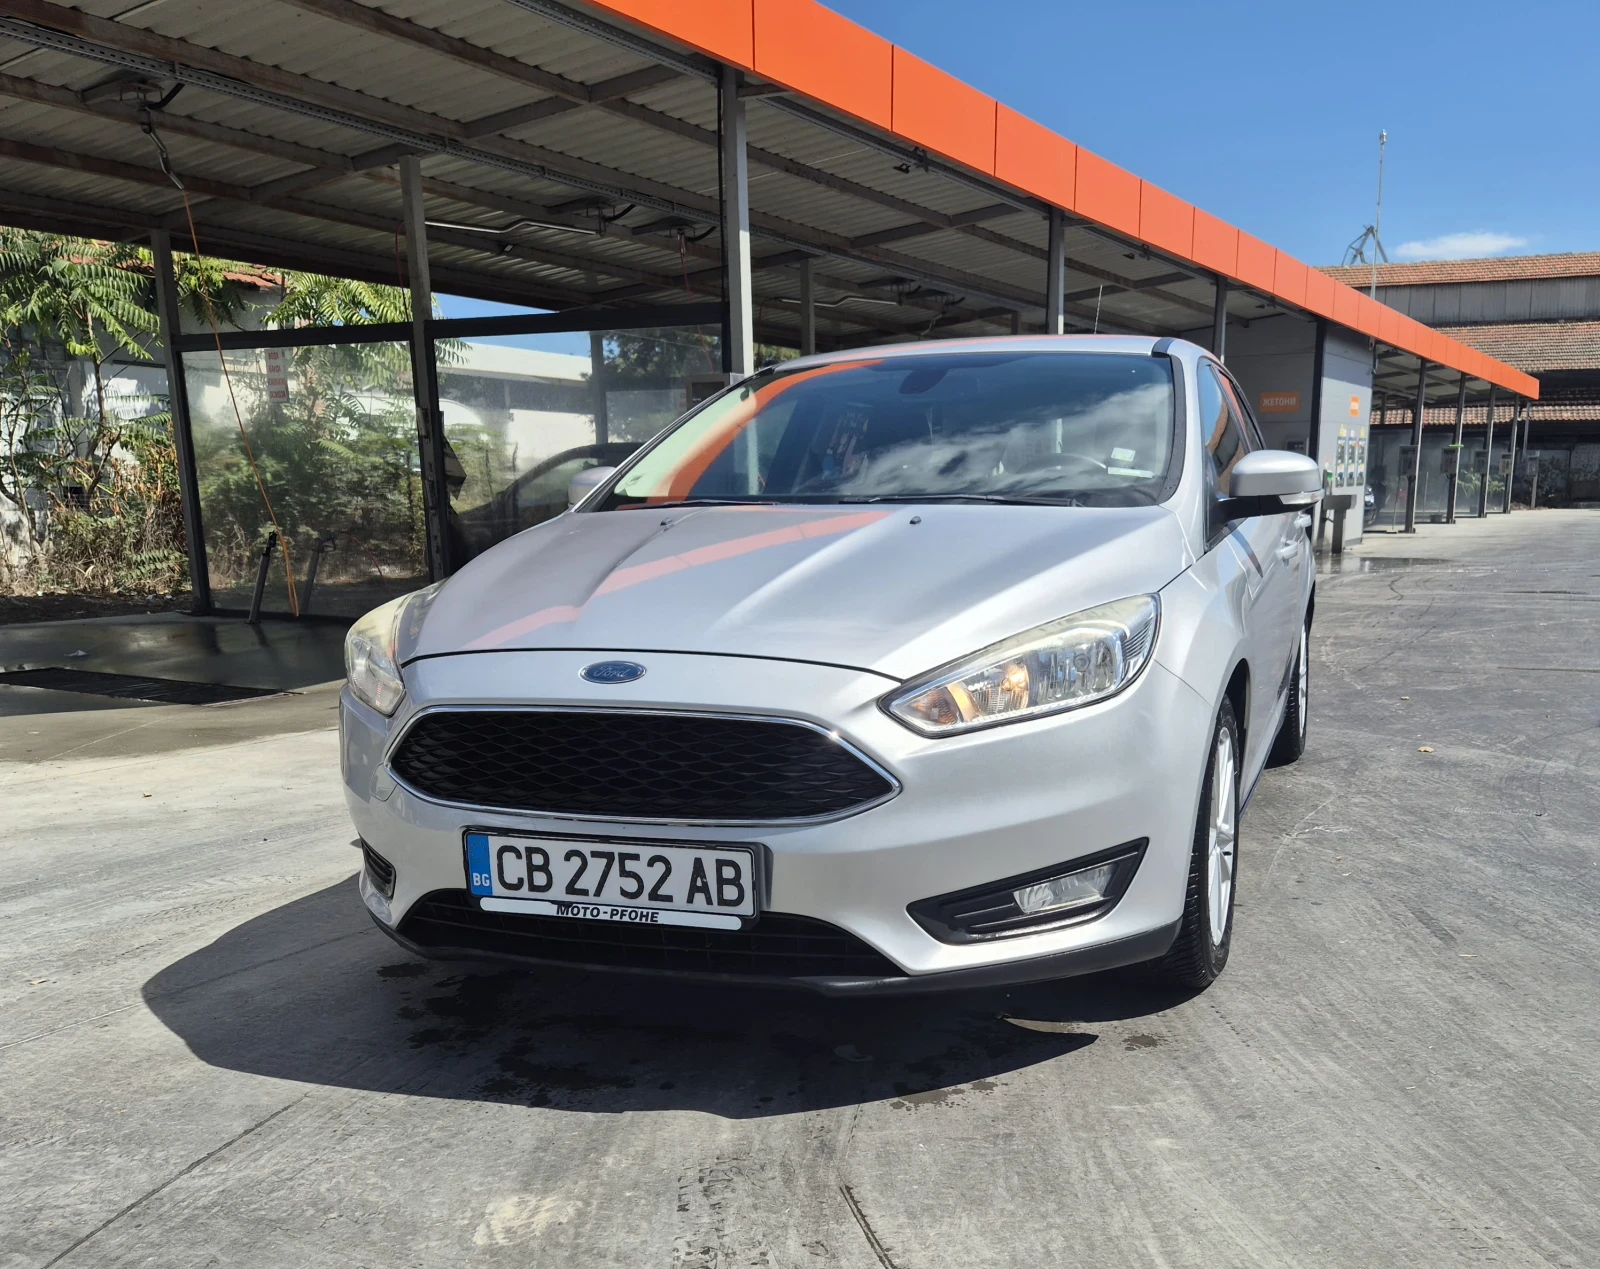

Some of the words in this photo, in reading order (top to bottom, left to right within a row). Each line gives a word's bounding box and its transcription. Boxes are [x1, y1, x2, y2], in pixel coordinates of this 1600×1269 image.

[1262, 396, 1297, 408] ЖЕТОНИ
[592, 664, 631, 678] Ford
[472, 873, 490, 887] BG
[496, 845, 553, 893] CB
[563, 849, 674, 903] 2752
[686, 857, 745, 908] AB
